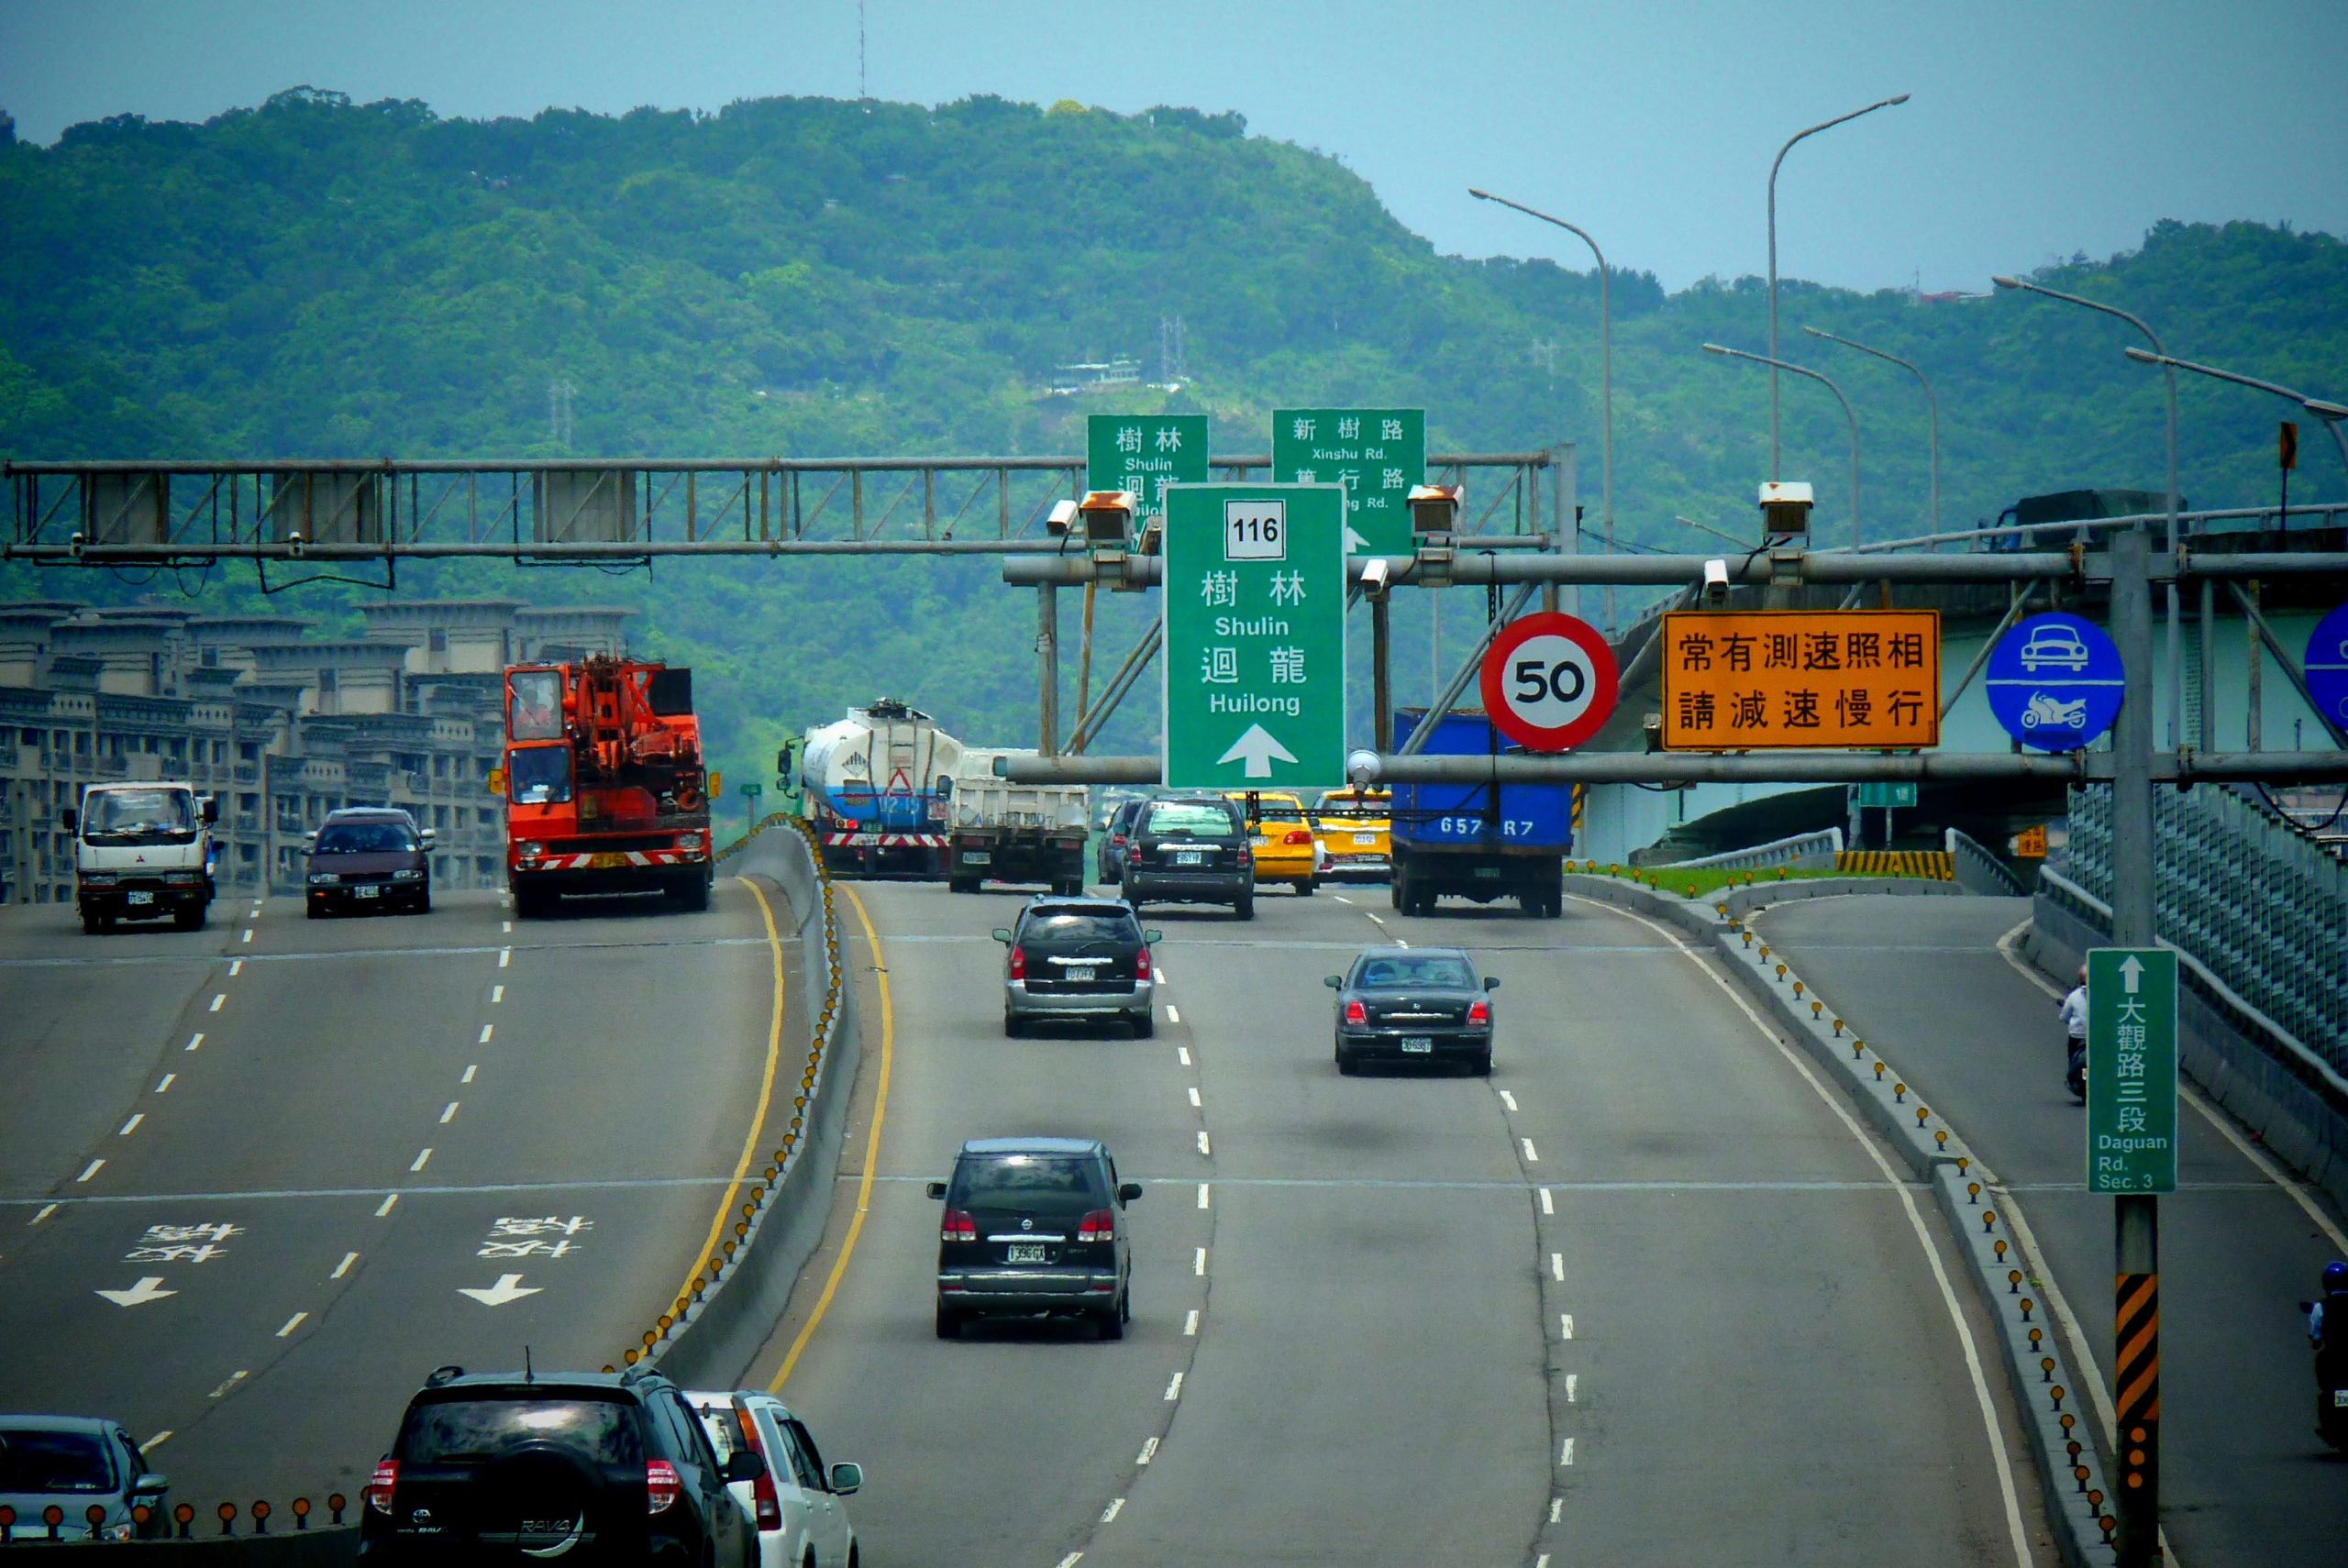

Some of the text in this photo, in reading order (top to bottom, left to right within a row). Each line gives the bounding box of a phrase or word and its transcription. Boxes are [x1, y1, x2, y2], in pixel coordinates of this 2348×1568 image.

[1115, 425, 1181, 454] 樹林
[1293, 417, 1403, 441] 新樹路
[1124, 458, 1173, 471] Shulin
[1312, 447, 1387, 460] Xinshu Rd.
[1368, 497, 1389, 509] Rd.
[1233, 517, 1279, 543] 116
[1201, 569, 1307, 607] 樹林
[1214, 616, 1290, 636] Shulin
[1678, 631, 1923, 672] 常有測速照相
[1201, 646, 1307, 684] 迴龍
[1515, 660, 1585, 703] 50
[1210, 692, 1301, 717] Huilong
[1678, 688, 1924, 730] 請減速慢行
[1440, 816, 1534, 836] 657 R7
[2116, 996, 2148, 1134] 大觀路三段
[2098, 1134, 2168, 1154] Daguan
[2098, 1156, 2129, 1172] Rd.
[2098, 1174, 2154, 1189] Sec. 3
[521, 1519, 570, 1532] RAV4
